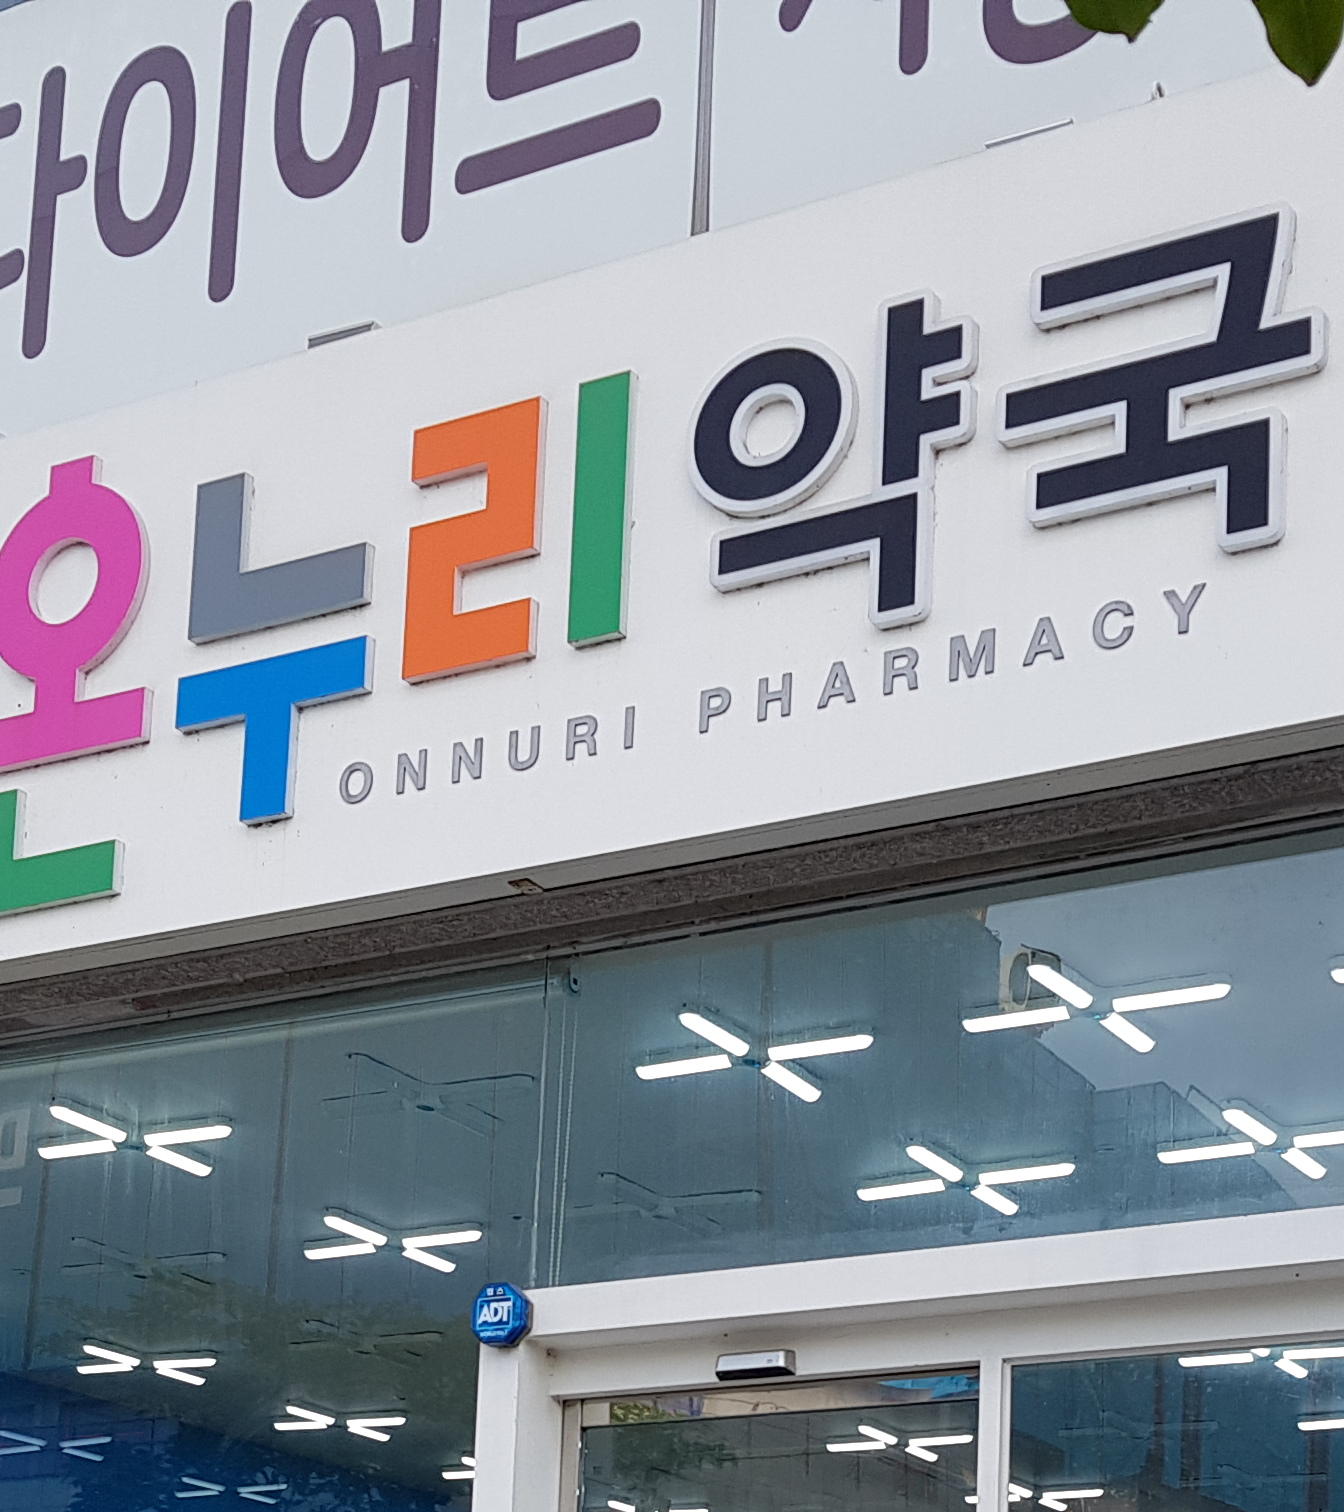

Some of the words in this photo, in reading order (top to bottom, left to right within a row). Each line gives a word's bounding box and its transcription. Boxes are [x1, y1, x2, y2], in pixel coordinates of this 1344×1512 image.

[339, 704, 638, 805] ONNURI
[698, 582, 1207, 734] PHARMACY
[477, 1300, 513, 1325] ADT
